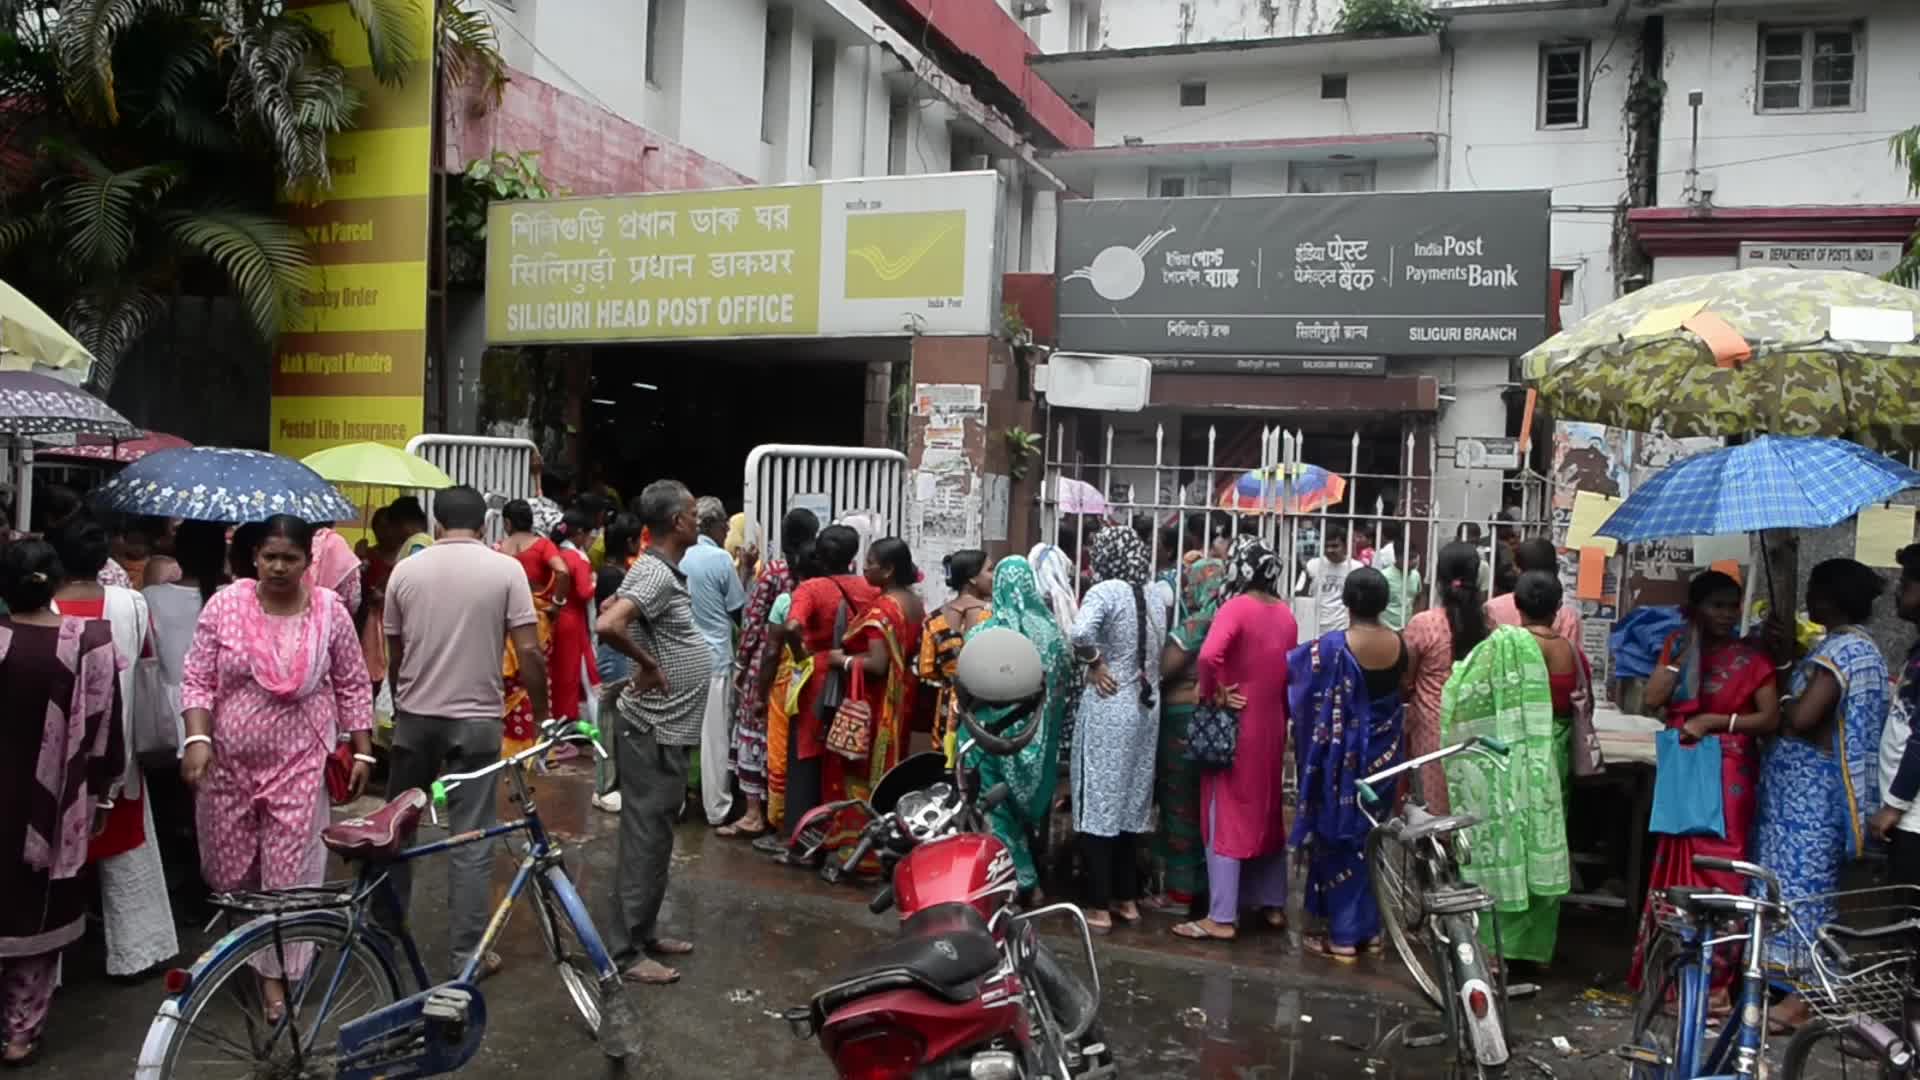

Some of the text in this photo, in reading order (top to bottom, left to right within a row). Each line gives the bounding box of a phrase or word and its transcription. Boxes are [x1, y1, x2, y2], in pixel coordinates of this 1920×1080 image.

[331, 219, 374, 241] Parcel
[510, 204, 792, 247] শিলিগুড়ি প্রধান ডাক ঘর
[1327, 234, 1369, 261] पोस्ट
[1414, 235, 1484, 256] India Post
[627, 253, 697, 284] प्रधान
[707, 249, 795, 279] डाकघर
[1338, 261, 1375, 291] बैंक
[1405, 263, 1519, 289] Payments Bank
[506, 293, 794, 332] SILIGURI HEAD POST OFFICE
[1408, 327, 1518, 341] SILIGURI BRANCH
[280, 418, 407, 441] Postal Life Insurance
